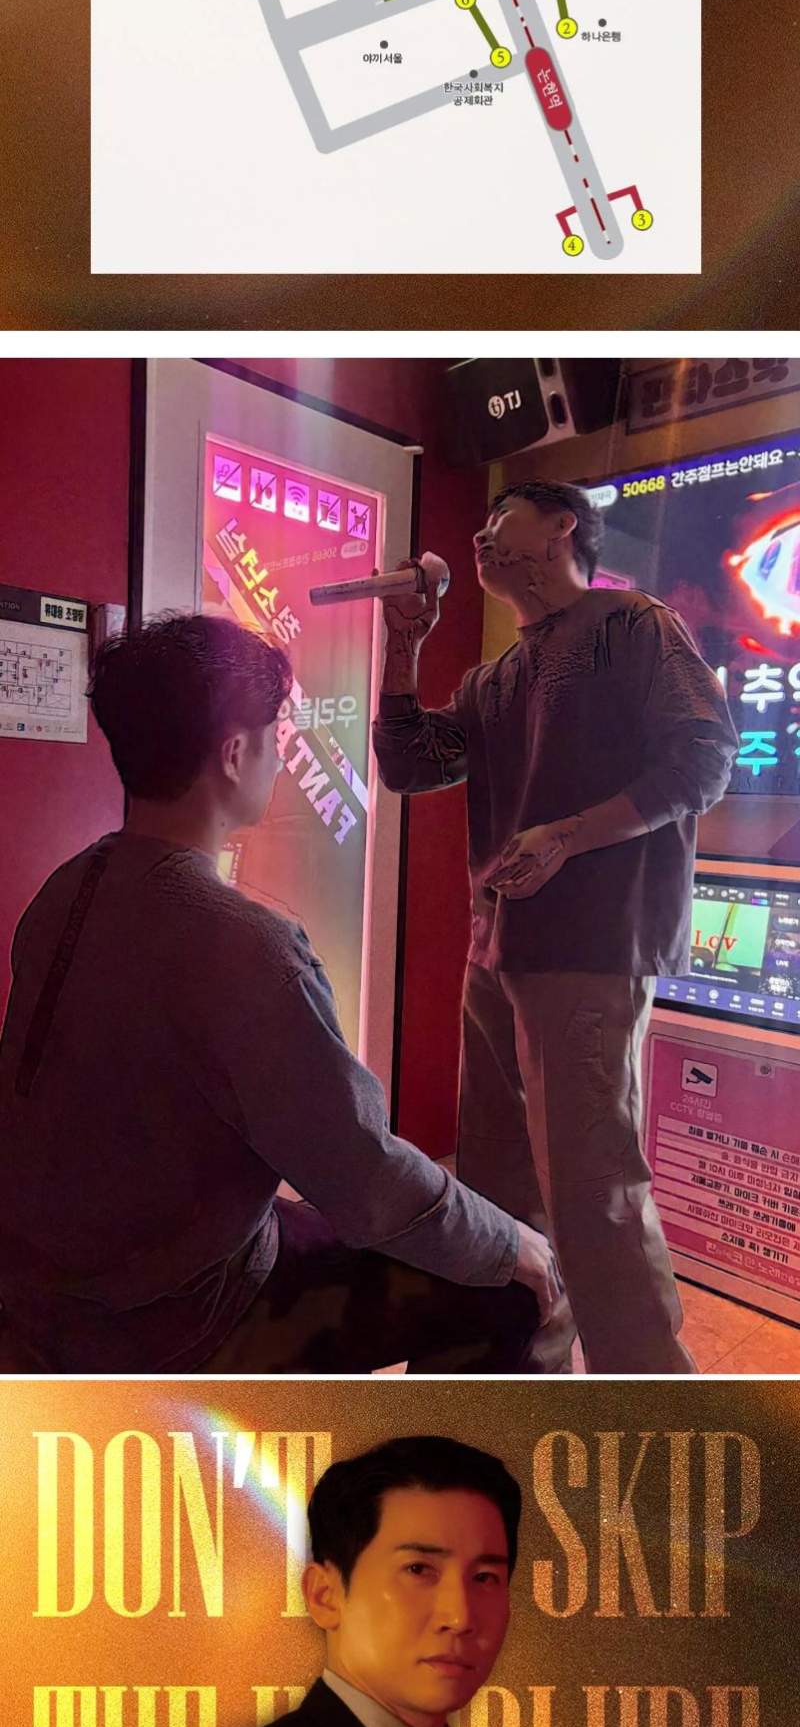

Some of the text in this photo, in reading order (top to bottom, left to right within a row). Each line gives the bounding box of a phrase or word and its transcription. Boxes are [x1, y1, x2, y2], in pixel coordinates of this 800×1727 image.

[580, 31, 622, 43] 하나은행
[443, 81, 504, 94] 한국사회복지
[536, 68, 563, 110] 논현역
[453, 94, 493, 106] 공제회관
[503, 389, 522, 411] TJ
[622, 475, 665, 498] 50668
[32, 1430, 762, 1618] DON'T SKIP
